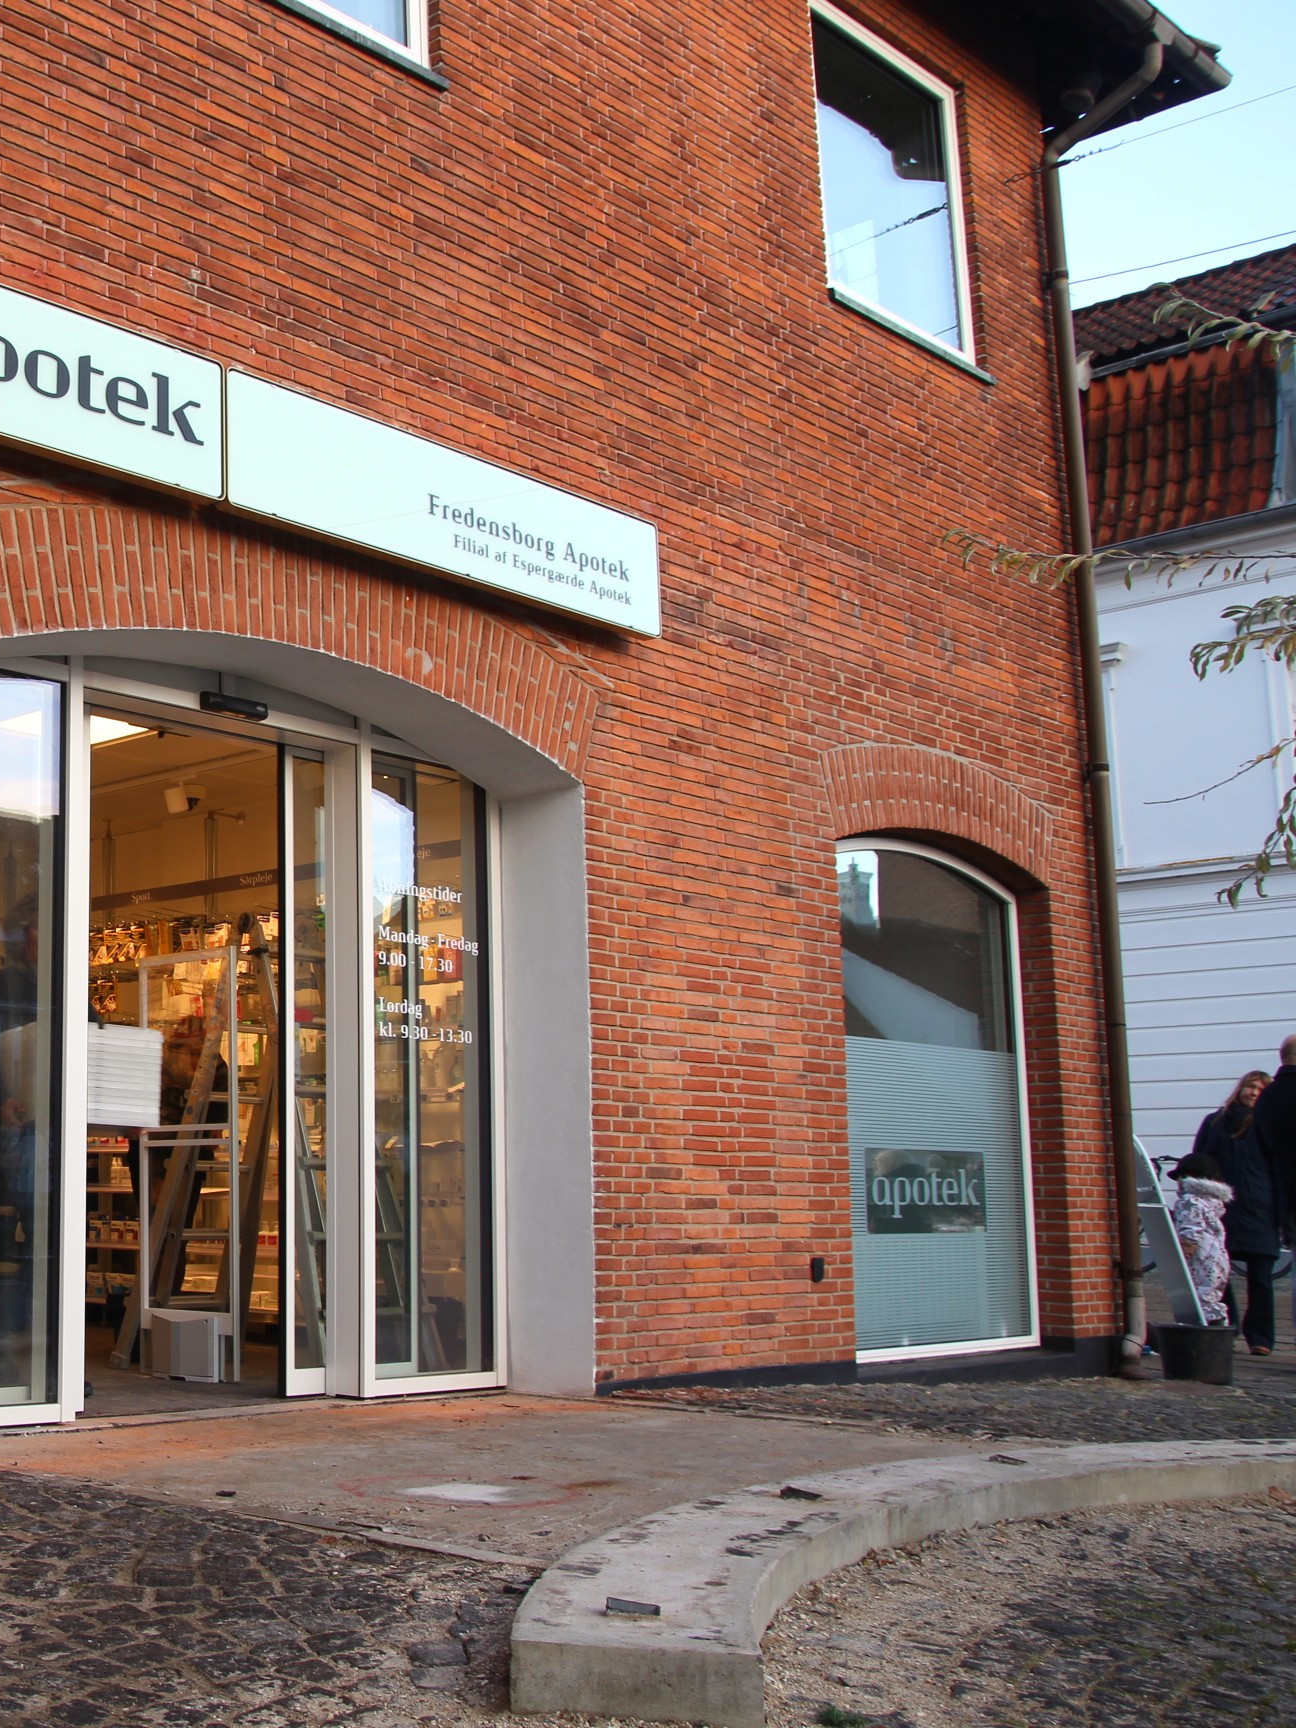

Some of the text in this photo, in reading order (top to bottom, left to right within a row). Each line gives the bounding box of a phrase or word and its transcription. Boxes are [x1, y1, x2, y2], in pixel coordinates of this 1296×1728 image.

[427, 493, 630, 582] Fredensborg Apotek
[453, 533, 632, 606] Filial af Espergærde Apotek
[378, 924, 429, 950] Mandag
[437, 933, 479, 956] Fredag
[378, 951, 407, 967] 9.00
[419, 955, 453, 973] 17.30
[378, 996, 423, 1019] Lørdag
[379, 1021, 397, 1038] kl.
[400, 1024, 429, 1041] 9.30
[439, 1028, 473, 1044] 13.30
[871, 1168, 981, 1219] apotek
